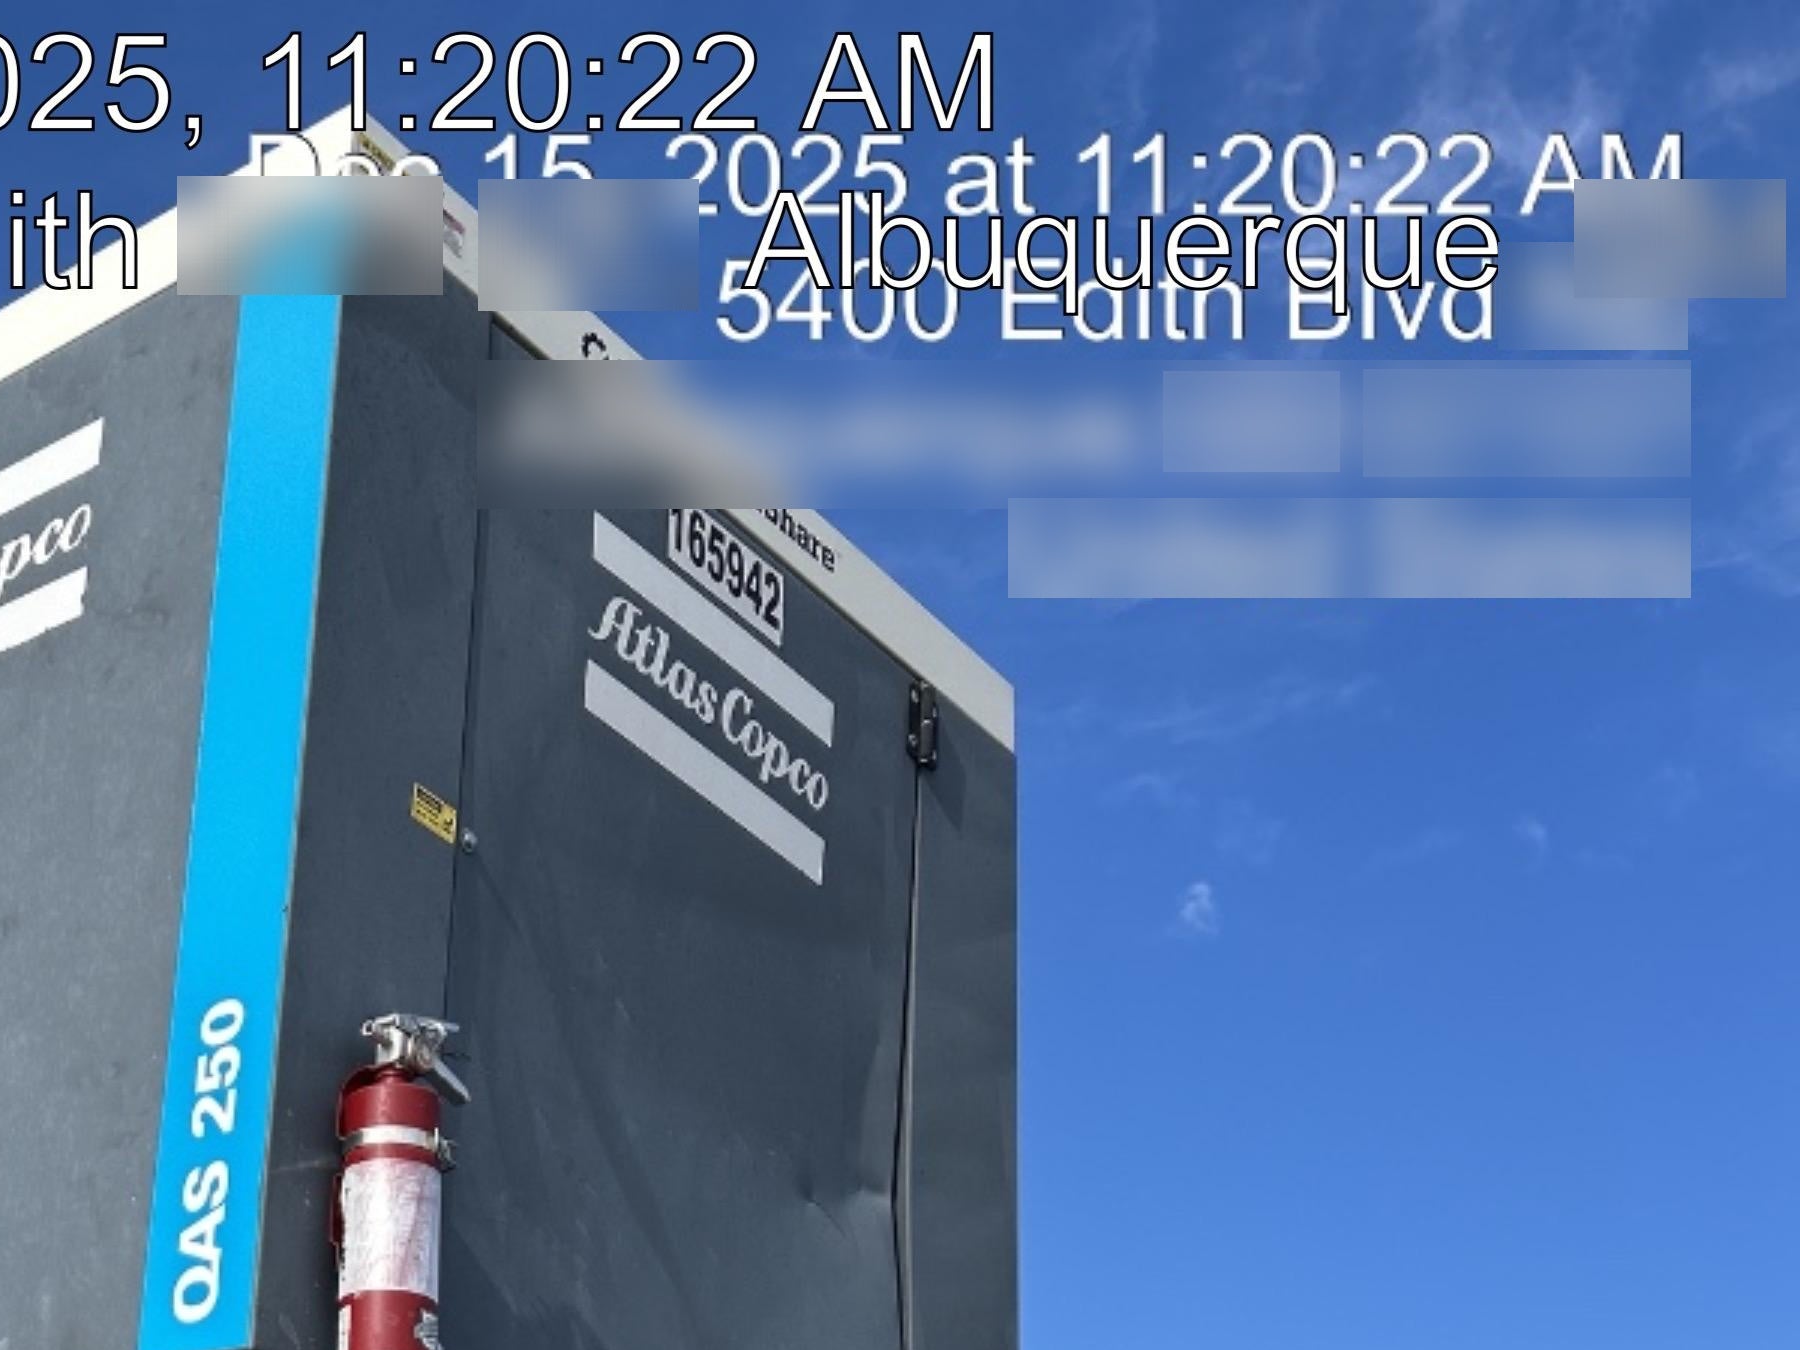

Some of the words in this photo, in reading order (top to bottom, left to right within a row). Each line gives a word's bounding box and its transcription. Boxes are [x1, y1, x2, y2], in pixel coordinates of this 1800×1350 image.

[669, 507, 784, 632] 165942
[587, 594, 719, 726] Atlas
[719, 687, 830, 812] Copco
[191, 998, 245, 1138] 250
[172, 1160, 230, 1324] QAS
